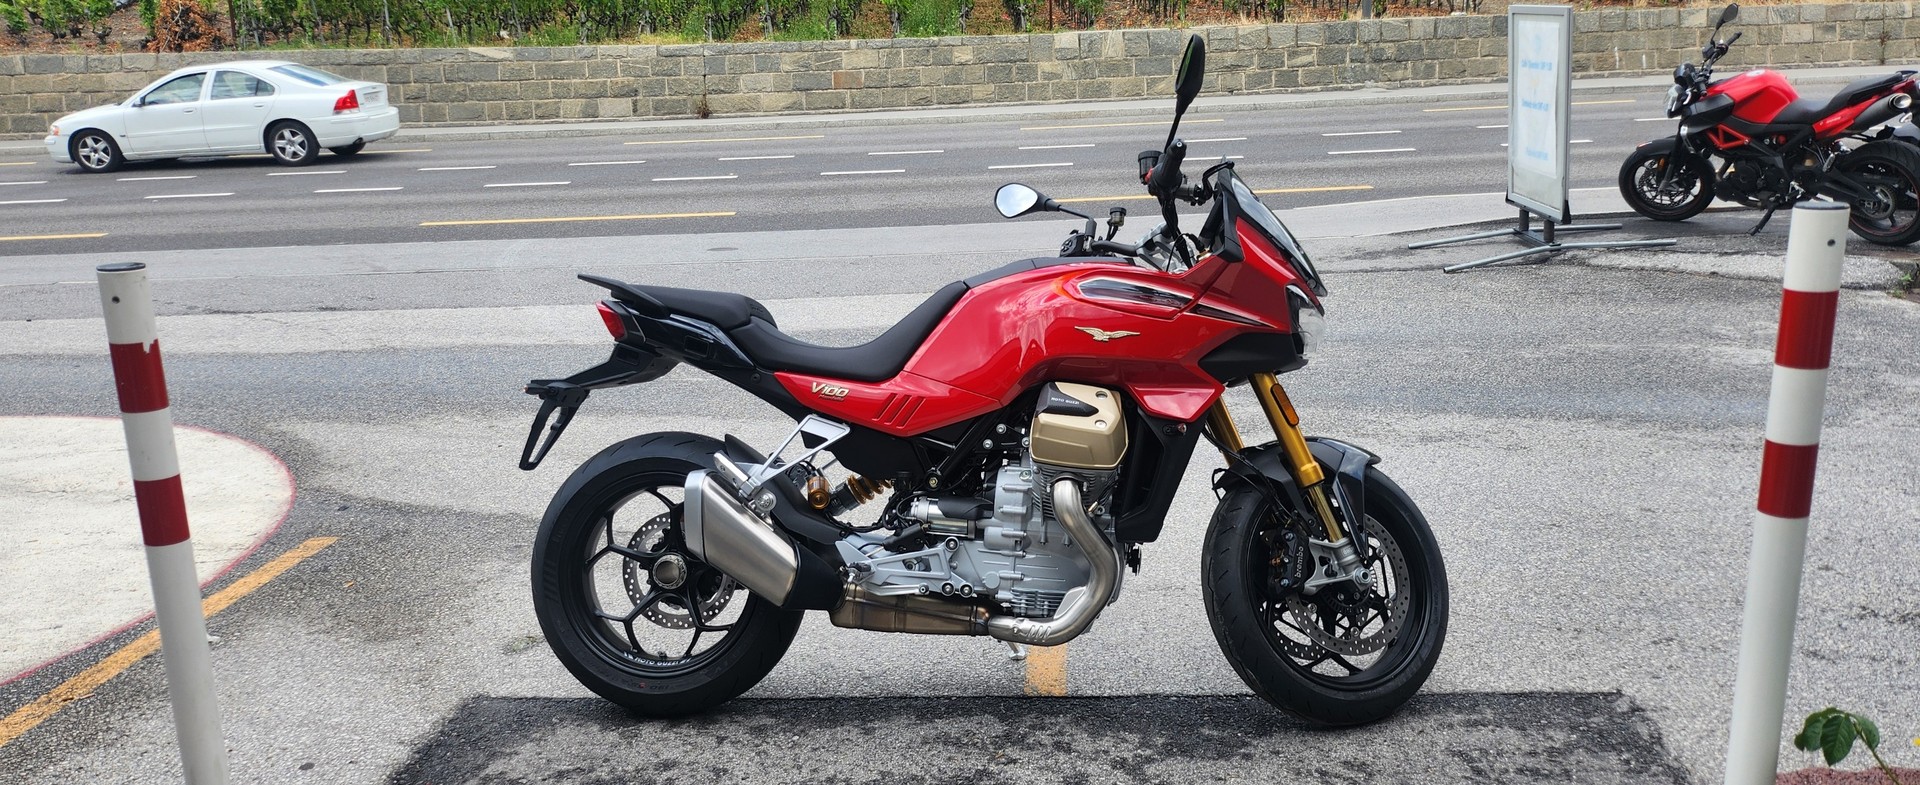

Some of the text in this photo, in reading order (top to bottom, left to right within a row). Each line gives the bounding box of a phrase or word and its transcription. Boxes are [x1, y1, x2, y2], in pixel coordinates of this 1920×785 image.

[812, 382, 849, 397] V100
[1295, 546, 1304, 578] brembo
[634, 656, 655, 665] MOTO
